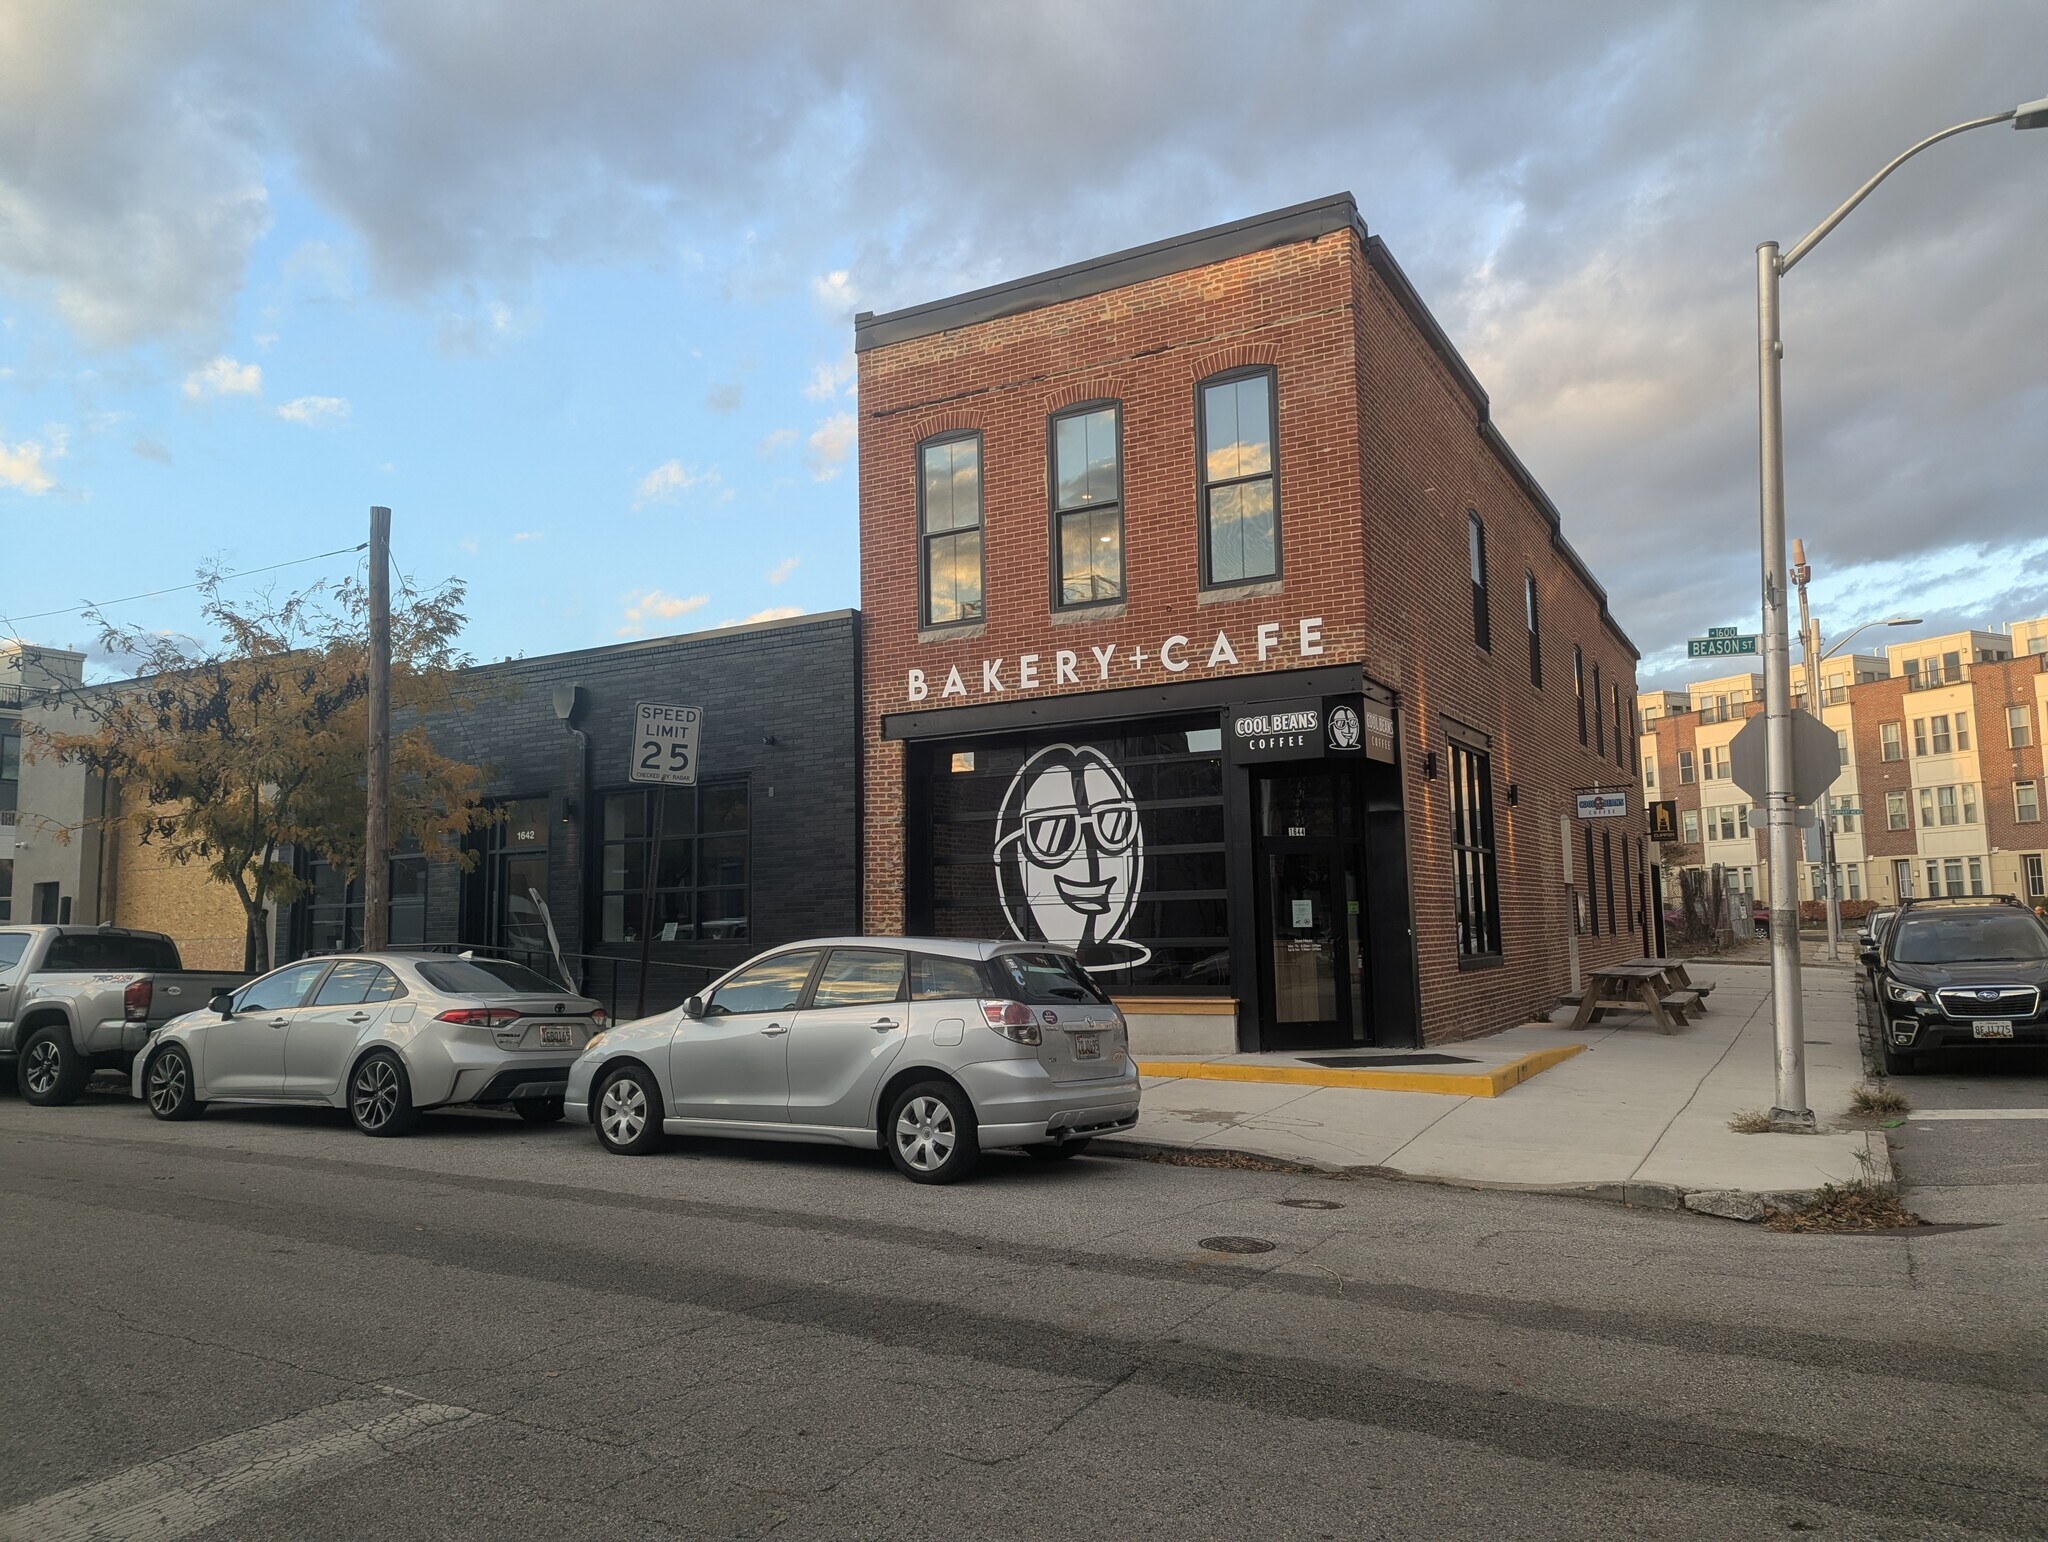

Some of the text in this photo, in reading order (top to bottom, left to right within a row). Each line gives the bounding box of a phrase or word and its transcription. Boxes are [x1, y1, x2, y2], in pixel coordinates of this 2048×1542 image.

[1715, 628, 1736, 637] 1600
[1693, 640, 1755, 656] BEASON ST.
[642, 707, 696, 722] SPEED
[646, 724, 689, 738] LIMIT
[1235, 711, 1317, 736] COOL BEANS
[1367, 713, 1393, 735] COOL BEANS
[1249, 735, 1304, 750] COFFEE
[1371, 736, 1391, 750] COFFEE
[640, 741, 689, 771] 25
[516, 830, 535, 840] 1642
